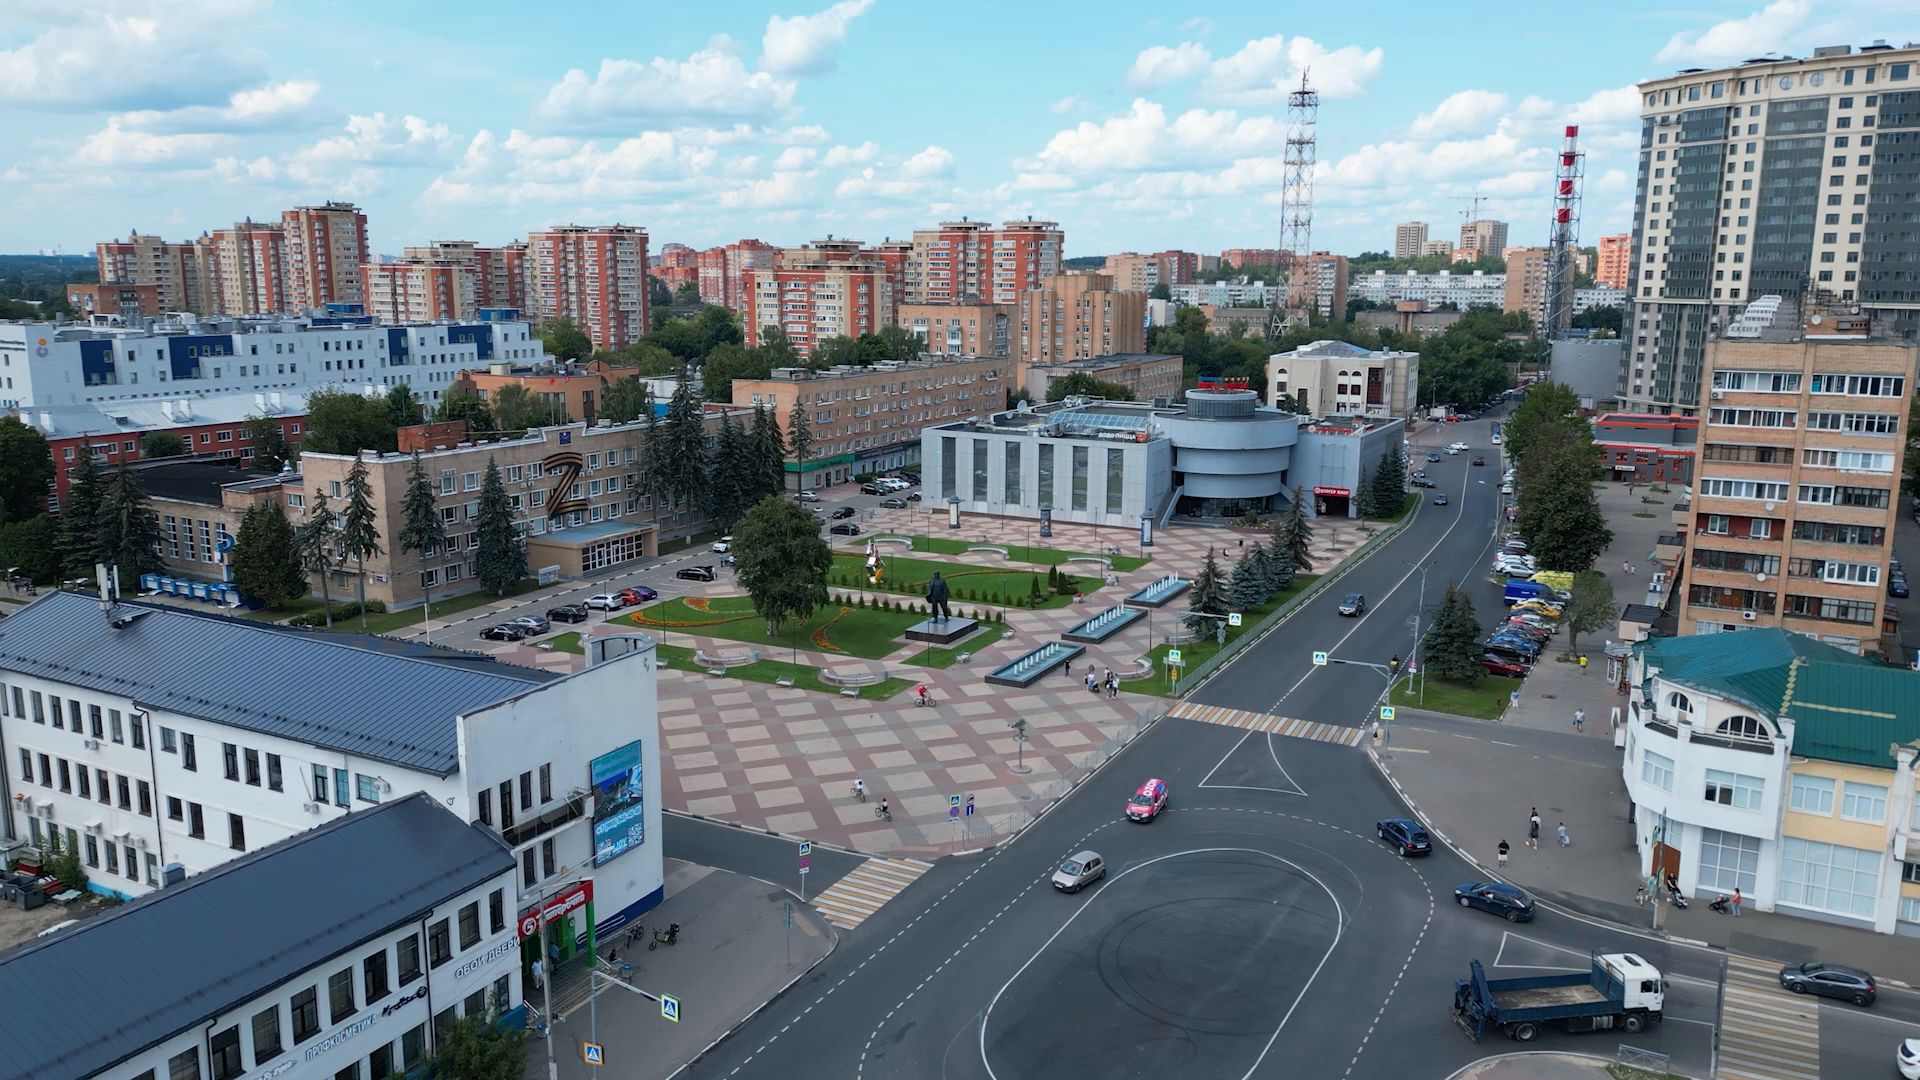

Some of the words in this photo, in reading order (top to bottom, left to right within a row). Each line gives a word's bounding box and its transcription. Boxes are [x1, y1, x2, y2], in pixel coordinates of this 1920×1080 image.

[455, 955, 485, 979] ОБОИ
[487, 936, 521, 964] ДВЕРИ
[305, 1013, 377, 1061] ПРОФКОСМЕТИКА
